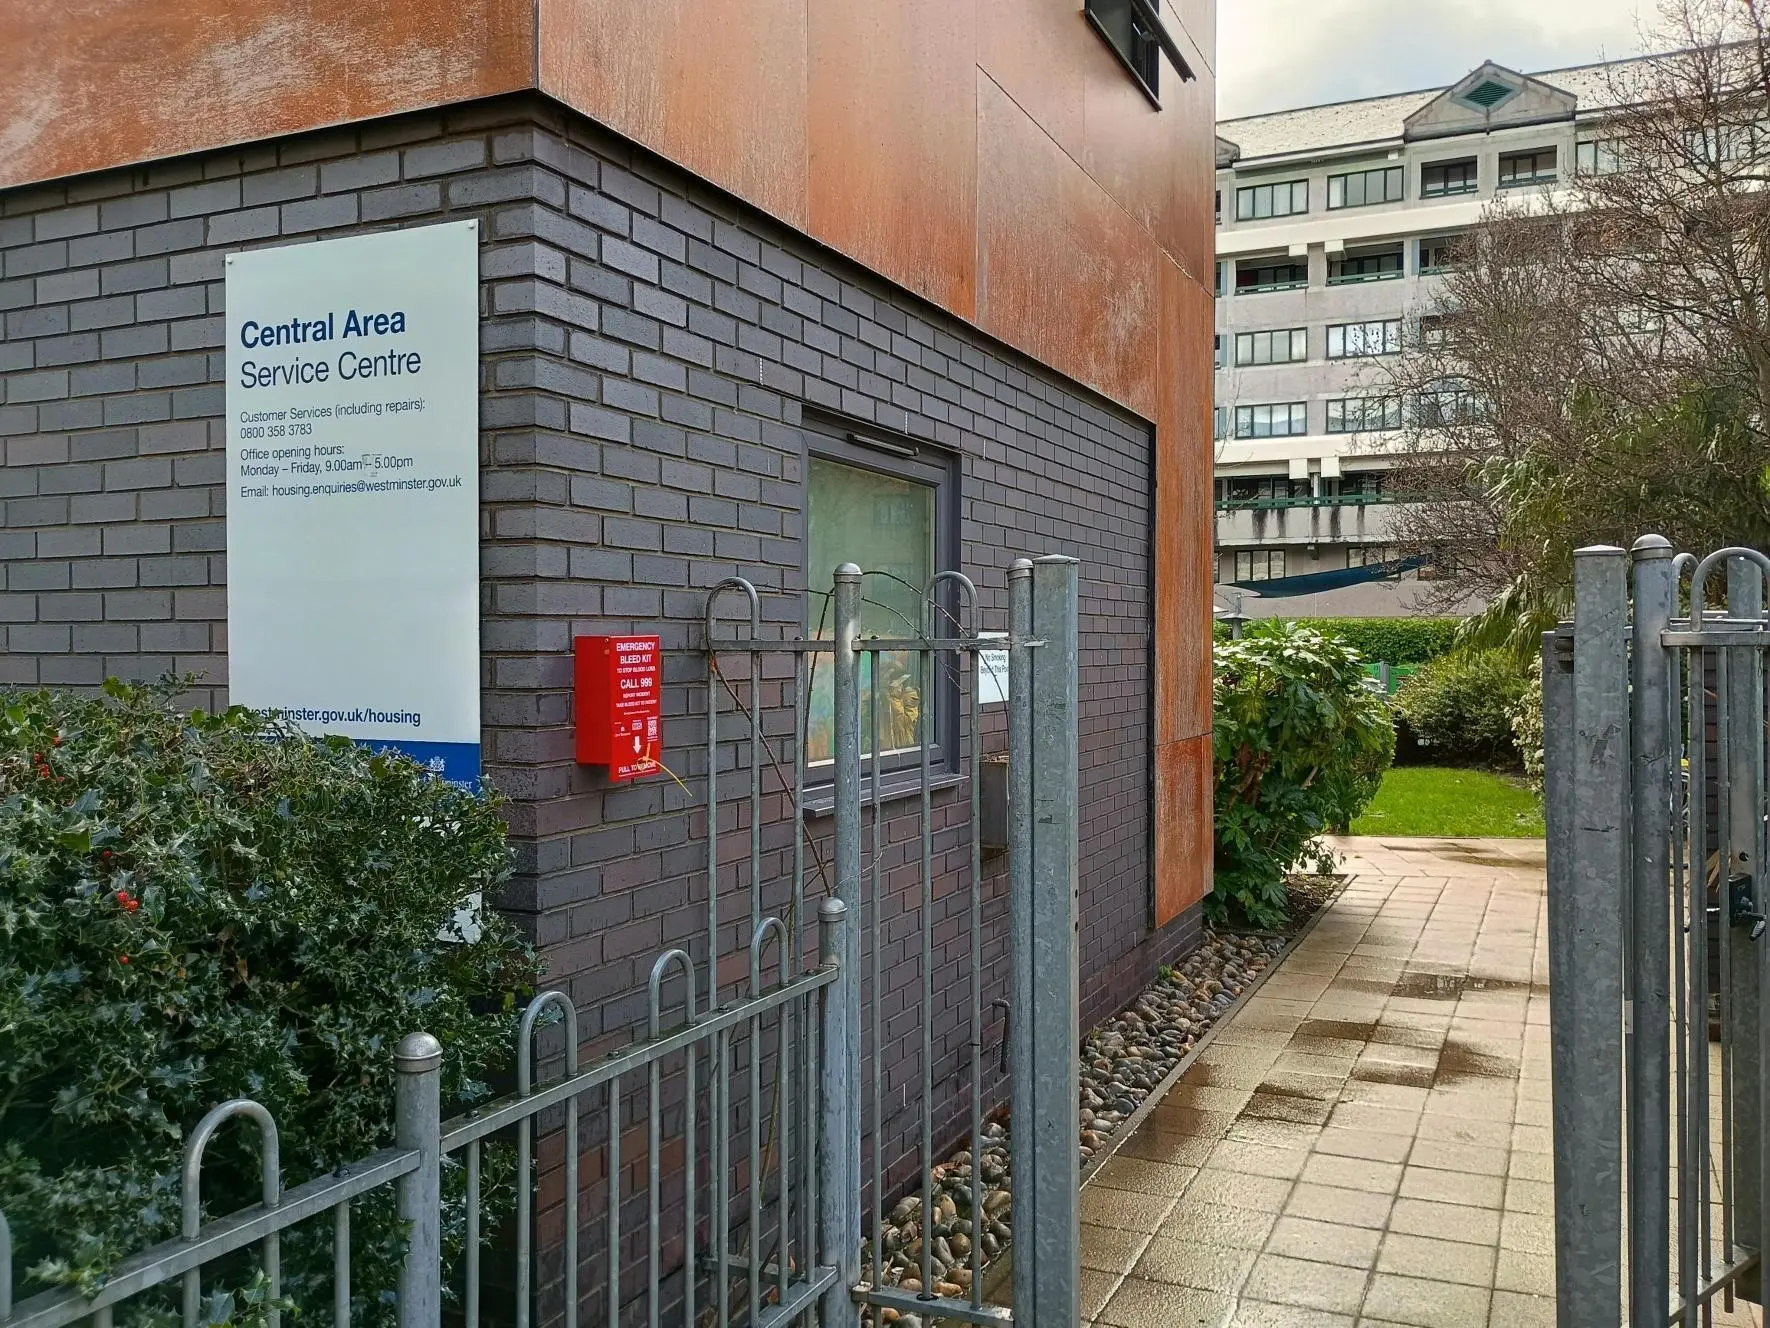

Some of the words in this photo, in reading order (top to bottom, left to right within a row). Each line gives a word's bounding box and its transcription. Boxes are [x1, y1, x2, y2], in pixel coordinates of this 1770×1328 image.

[240, 312, 334, 349] Central
[342, 309, 406, 339] Area
[240, 356, 330, 389] Service
[338, 349, 421, 380] Centre
[240, 410, 287, 423] Customer
[290, 406, 332, 420] Services
[335, 402, 382, 419] (including
[385, 397, 425, 414] repairs):
[240, 427, 265, 439] 0800
[267, 425, 286, 438] 358
[288, 423, 312, 436] 3783
[240, 448, 270, 460] Office
[272, 446, 311, 461] opening
[314, 444, 345, 456] hours:
[240, 464, 279, 477] Monday
[291, 461, 322, 476] Friday,
[325, 459, 363, 472] 9.00am
[374, 456, 413, 470] 5.00pm
[240, 485, 269, 498] Email:
[272, 475, 462, 498] housing.enquiries@westminster.gov.uk
[616, 642, 656, 652] EMERGENCY
[620, 655, 641, 664] BLEED
[642, 654, 652, 663] KIT
[620, 678, 639, 689] CALL
[640, 677, 653, 688] 999
[618, 765, 631, 774] PULL
